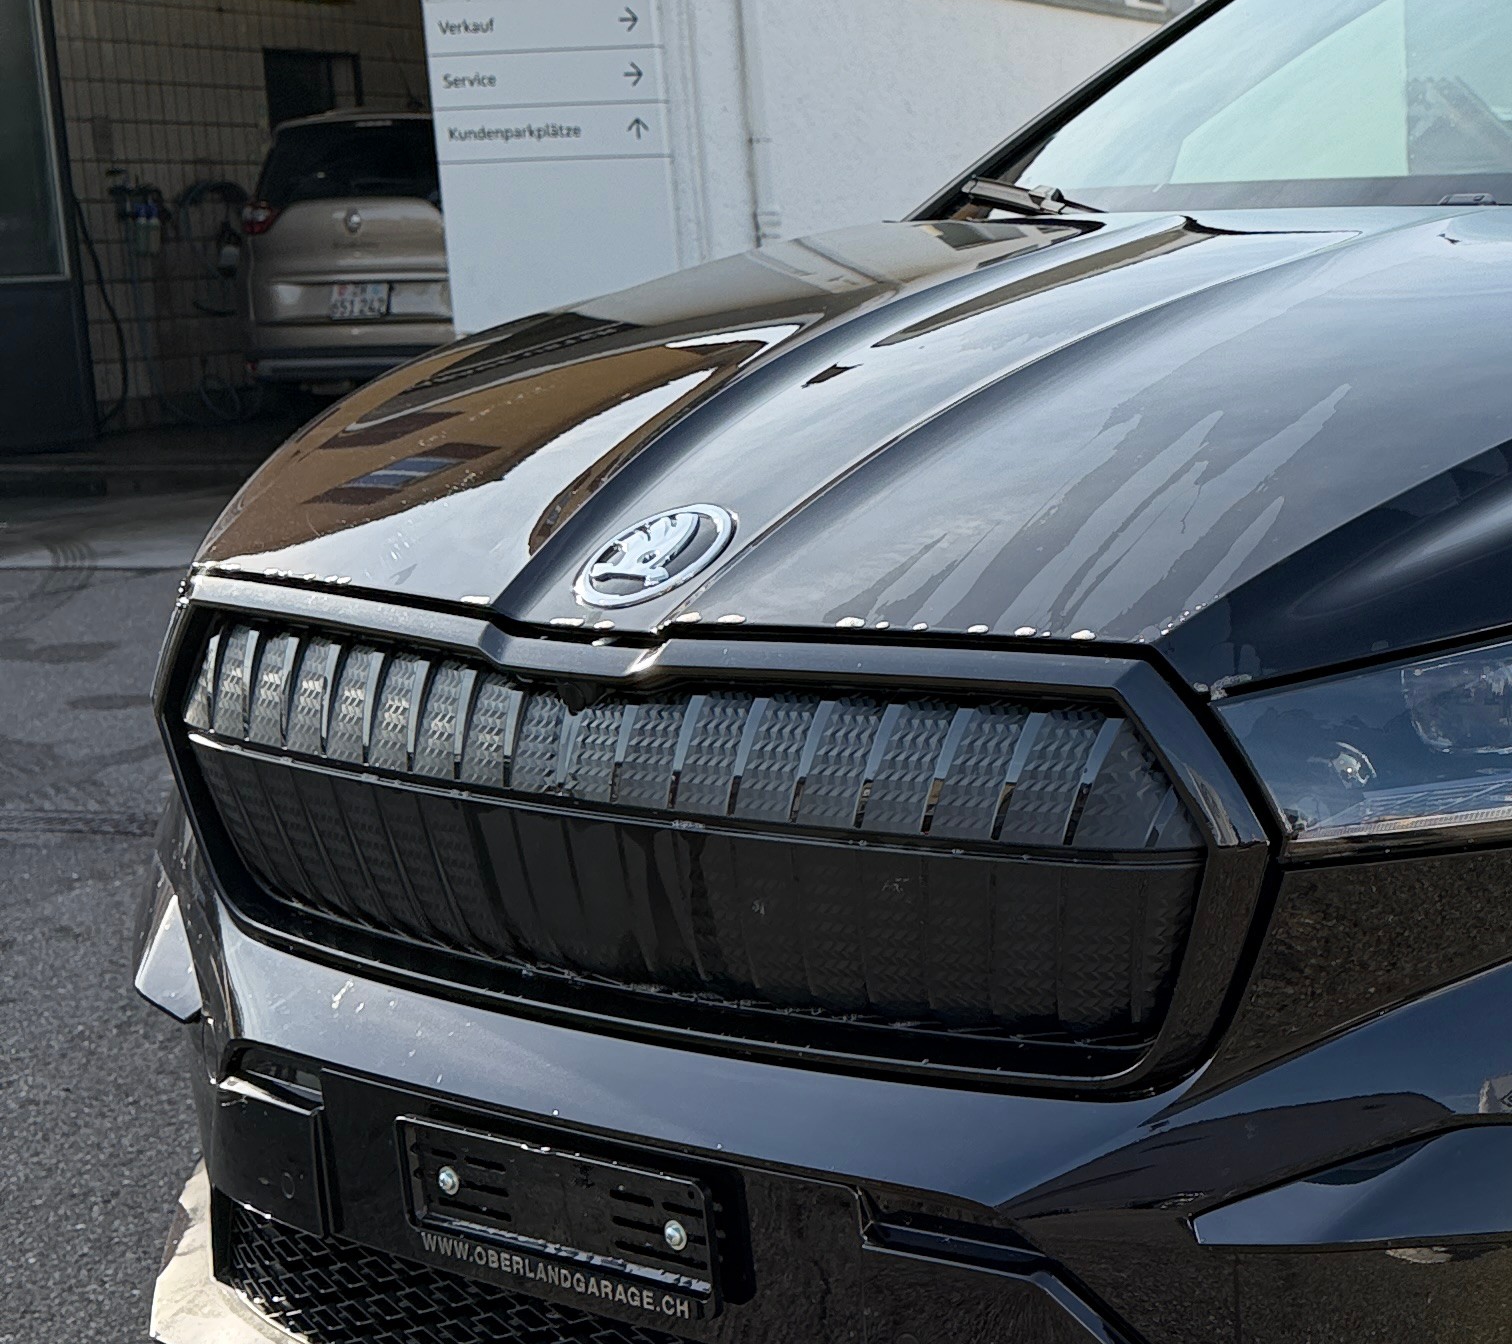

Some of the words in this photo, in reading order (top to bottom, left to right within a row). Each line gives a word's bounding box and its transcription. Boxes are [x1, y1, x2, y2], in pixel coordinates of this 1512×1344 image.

[438, 16, 495, 35] Verkauf
[442, 71, 497, 89] Service
[447, 122, 582, 143] Kundenparkplätze
[420, 1231, 690, 1320] WWW.OBERLANDGARAGE.CH
